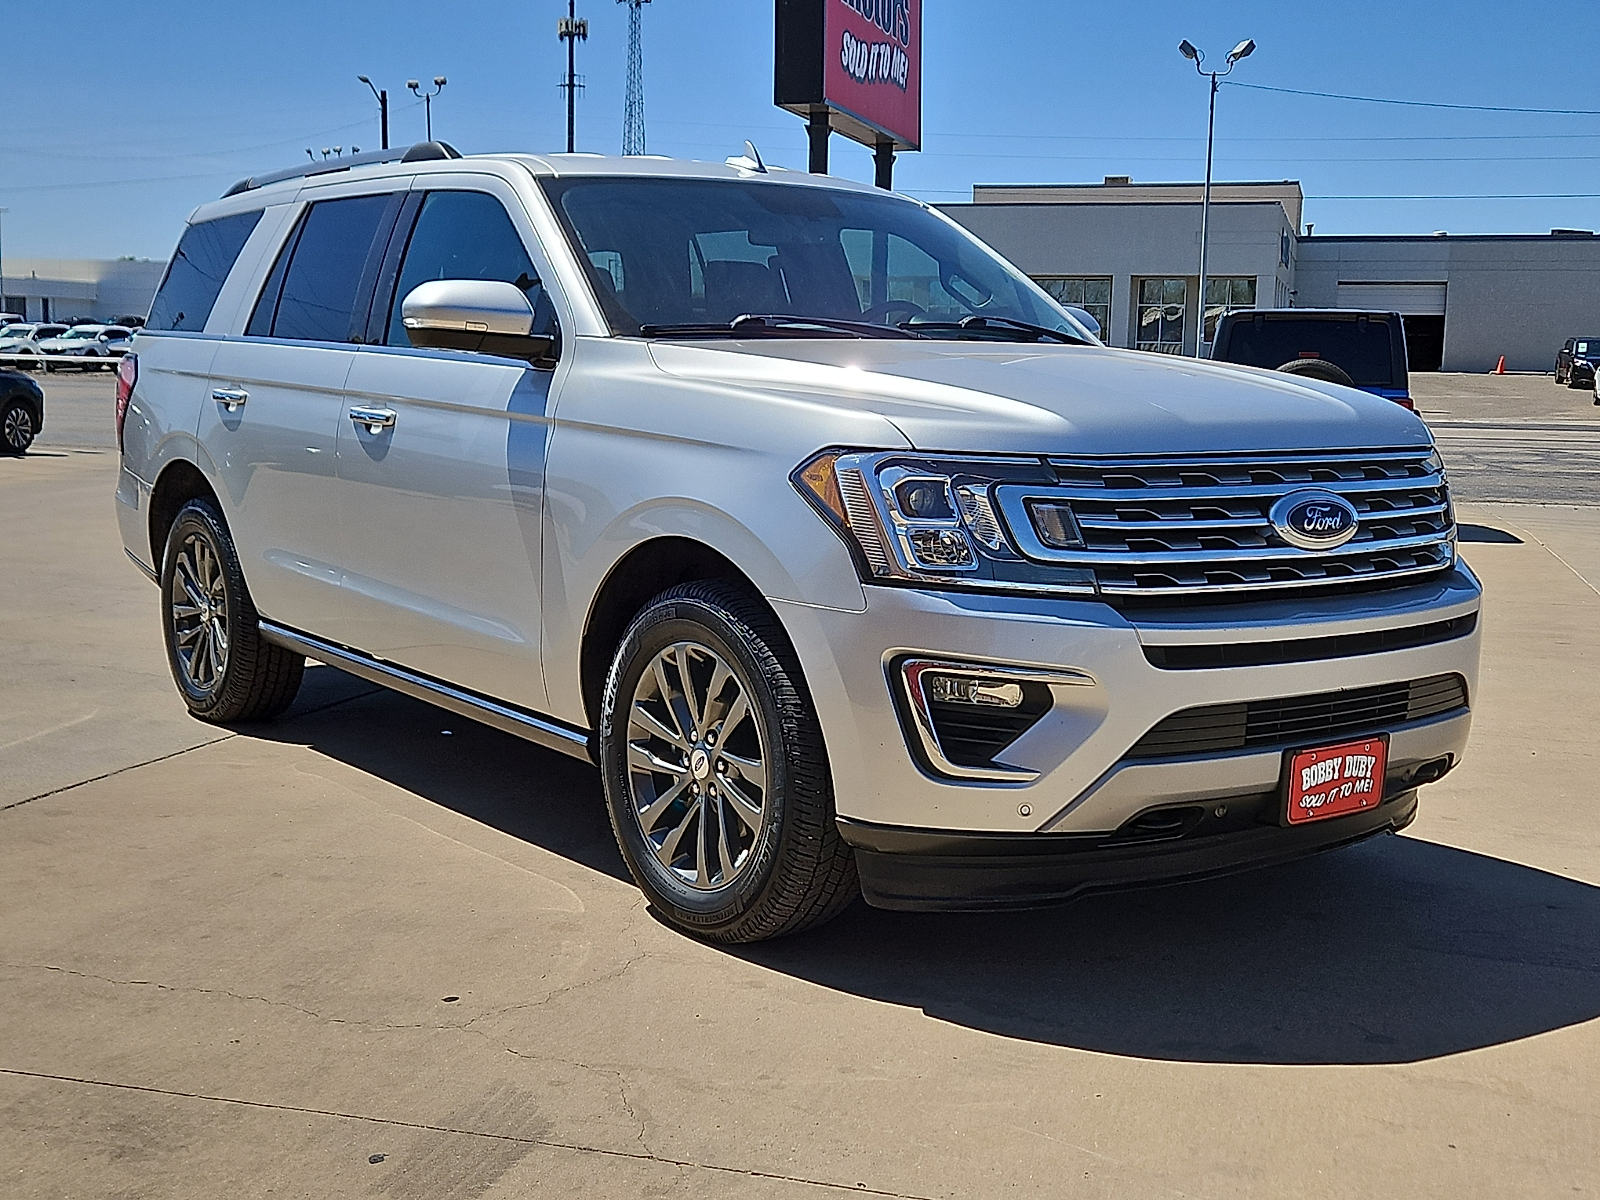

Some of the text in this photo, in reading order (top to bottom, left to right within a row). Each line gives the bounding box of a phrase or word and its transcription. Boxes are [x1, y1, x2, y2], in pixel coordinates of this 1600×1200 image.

[841, 31, 909, 89] SOLD IT TO ME!
[1304, 506, 1342, 531] Ford
[1301, 755, 1376, 791] BOBBY DUBY
[1299, 778, 1374, 808] SOLD IT TO ME!
